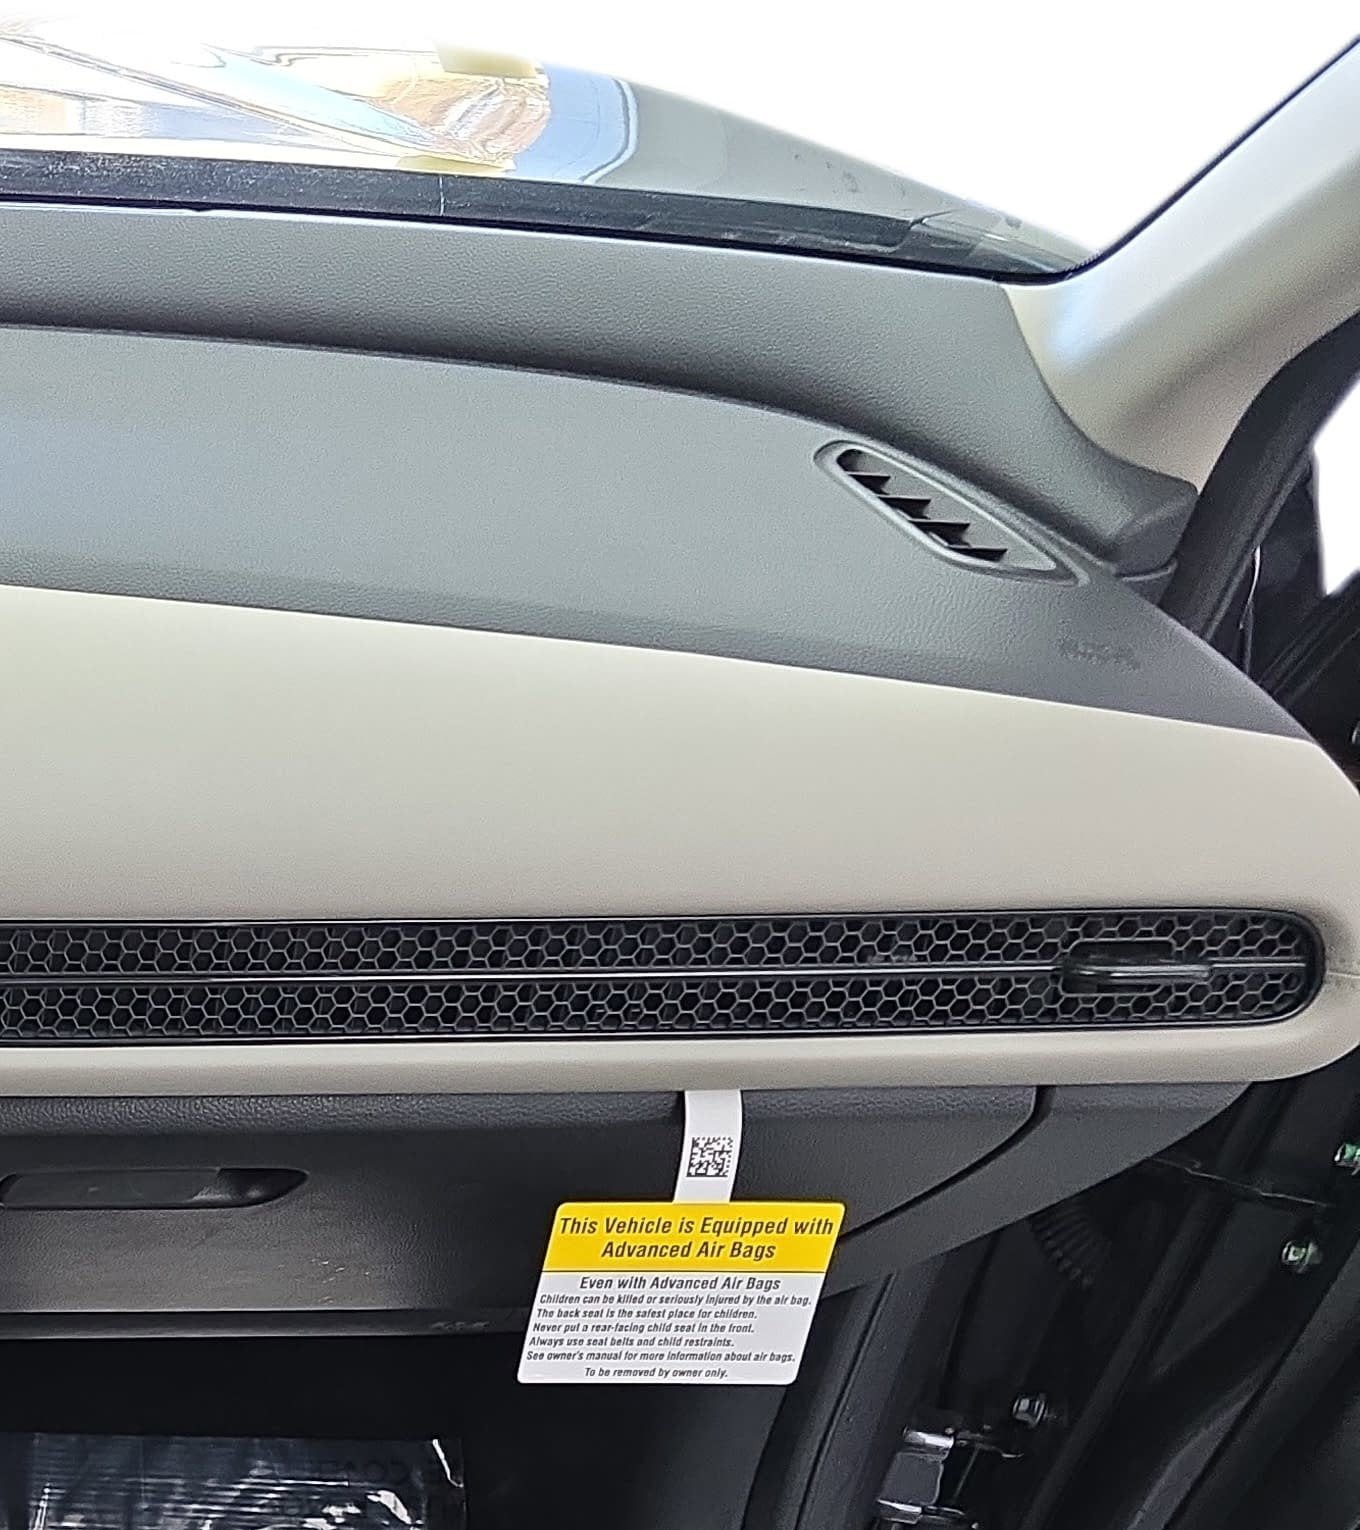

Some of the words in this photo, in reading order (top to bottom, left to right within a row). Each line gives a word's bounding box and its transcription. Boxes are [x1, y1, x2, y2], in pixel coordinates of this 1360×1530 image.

[560, 1217, 598, 1235] This
[605, 1216, 672, 1235] Vehicle
[678, 1216, 695, 1235] is
[700, 1216, 789, 1238] Equipped
[794, 1217, 834, 1236] with
[601, 1241, 693, 1258] Advanced
[696, 1241, 726, 1258] Air
[729, 1241, 777, 1262] Bags
[580, 1276, 613, 1290] Even
[617, 1276, 647, 1290] with
[650, 1276, 719, 1290] Advanced
[720, 1276, 745, 1290] Air
[746, 1276, 781, 1292] Bags
[540, 1294, 581, 1305] Children
[582, 1295, 600, 1305] can
[602, 1294, 615, 1305] be
[617, 1294, 645, 1305] killed
[646, 1296, 658, 1305] or
[658, 1294, 704, 1306] seriously
[705, 1294, 741, 1306] injured
[743, 1295, 754, 1307] by
[756, 1294, 774, 1306] the
[774, 1295, 789, 1306] air
[790, 1295, 812, 1307] bag.
[537, 1308, 555, 1319] The
[557, 1308, 581, 1319] back
[582, 1308, 604, 1319] seat
[606, 1308, 615, 1319] is
[617, 1308, 633, 1319] the
[635, 1308, 667, 1319] safest
[668, 1308, 695, 1321] place
[699, 1308, 712, 1320] for
[713, 1308, 758, 1320] children.
[532, 1322, 562, 1333] Never
[563, 1322, 581, 1334] put
[582, 1324, 589, 1333] a
[590, 1322, 645, 1334] rear-facing
[646, 1322, 673, 1333] child
[673, 1323, 696, 1334] seat
[697, 1323, 708, 1334] in
[710, 1323, 726, 1334] the
[728, 1323, 755, 1334] front.
[528, 1336, 565, 1348] Always
[566, 1338, 584, 1347] use
[586, 1336, 608, 1347] seat
[610, 1336, 634, 1347] belts
[636, 1336, 655, 1347] and
[657, 1336, 682, 1347] child
[683, 1337, 735, 1348] restraints.
[526, 1350, 544, 1361] See
[546, 1350, 584, 1361] owner's
[585, 1351, 622, 1361] manual
[623, 1351, 639, 1361] for
[640, 1353, 666, 1361] more
[666, 1351, 723, 1362] information
[723, 1352, 753, 1362] about
[753, 1352, 768, 1362] air
[769, 1352, 796, 1363] bags.
[585, 1367, 596, 1377] To
[598, 1367, 610, 1377] be
[612, 1367, 657, 1377] removed
[658, 1368, 670, 1379] by
[671, 1369, 703, 1378] owner
[704, 1368, 729, 1379] only.
